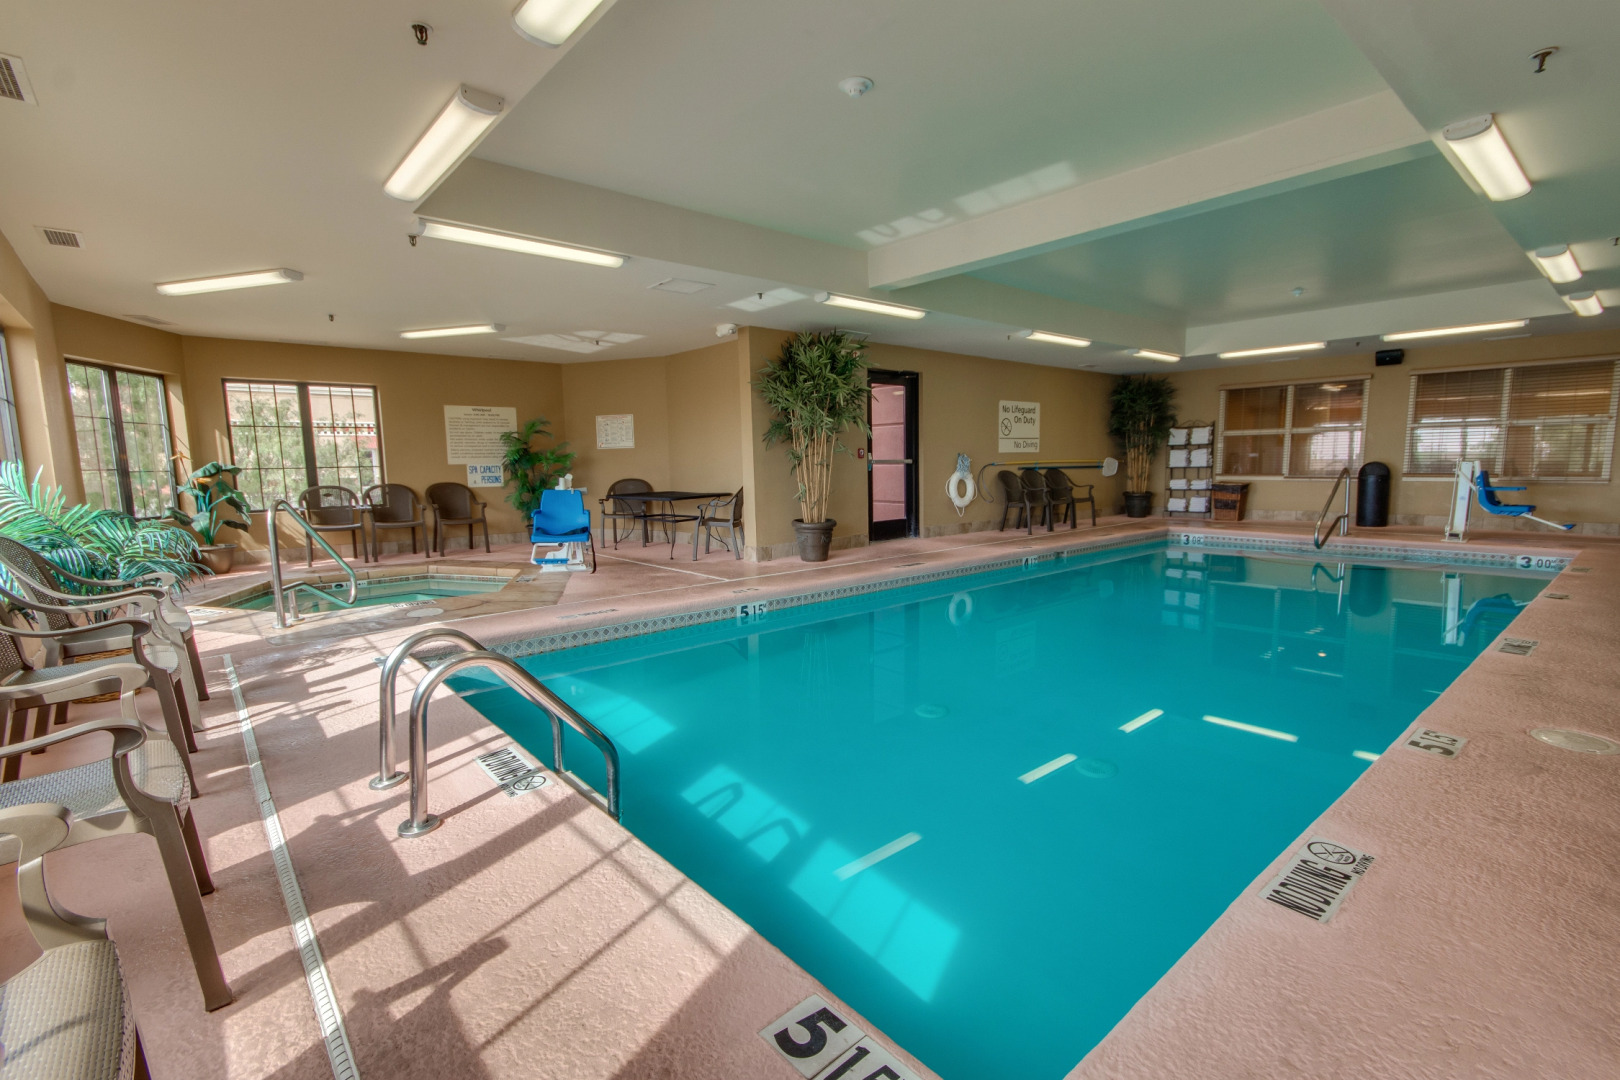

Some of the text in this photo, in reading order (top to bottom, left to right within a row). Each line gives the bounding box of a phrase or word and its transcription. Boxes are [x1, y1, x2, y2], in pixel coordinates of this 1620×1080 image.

[1002, 405, 1036, 416] No Lifeguard
[1013, 415, 1036, 426] On Duty
[1013, 440, 1038, 450] No Diving
[468, 465, 502, 474] SPA CAPACITY
[480, 475, 502, 484] PERSONS
[1183, 534, 1190, 545] 3
[1520, 556, 1532, 569] 3
[740, 604, 749, 617] 5
[477, 747, 513, 763] NO
[1407, 740, 1455, 757] 5
[484, 755, 532, 782] DIVING
[1266, 859, 1353, 921] NO DIVING
[773, 1006, 848, 1059] 5
